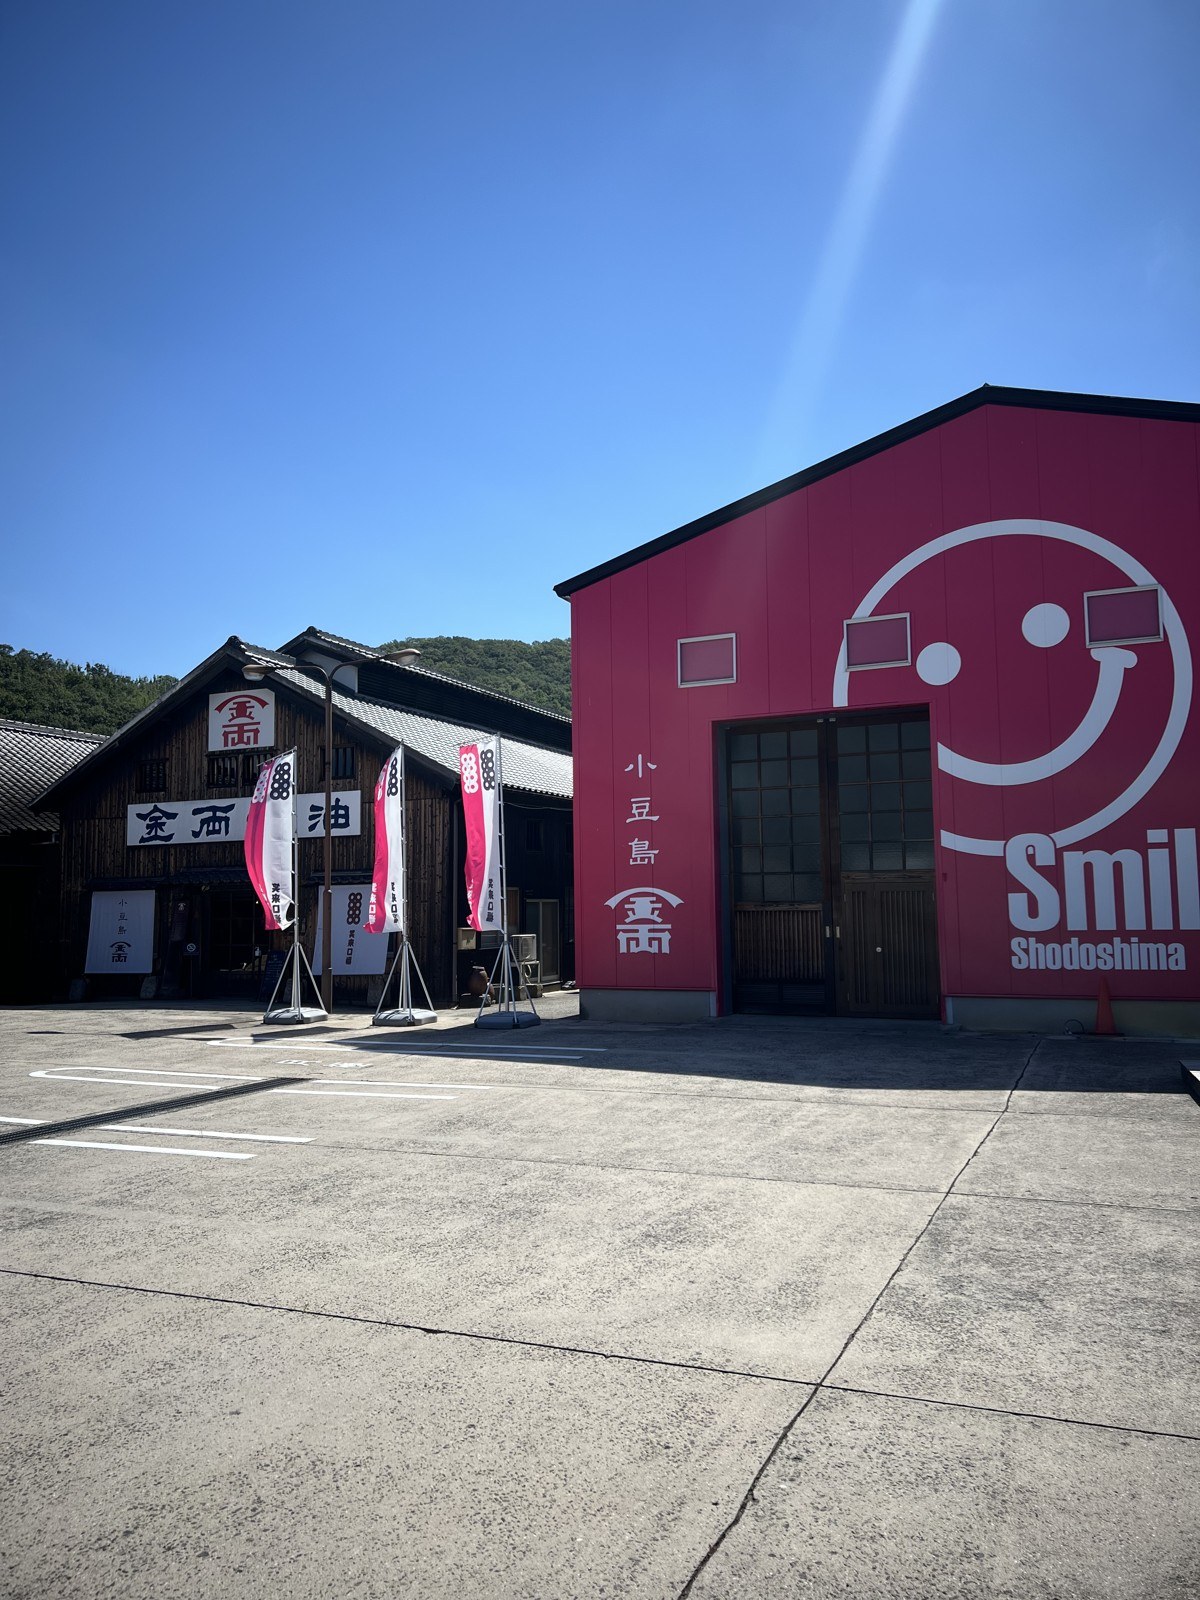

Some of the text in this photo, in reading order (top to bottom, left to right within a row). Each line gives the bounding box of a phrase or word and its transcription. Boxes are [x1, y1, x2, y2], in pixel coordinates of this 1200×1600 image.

[135, 797, 351, 844] 金両油
[624, 753, 660, 865] 小豆島
[1005, 827, 1200, 932] Smil
[117, 898, 129, 935] 小豆島
[1010, 936, 1187, 972] Shodoshima
